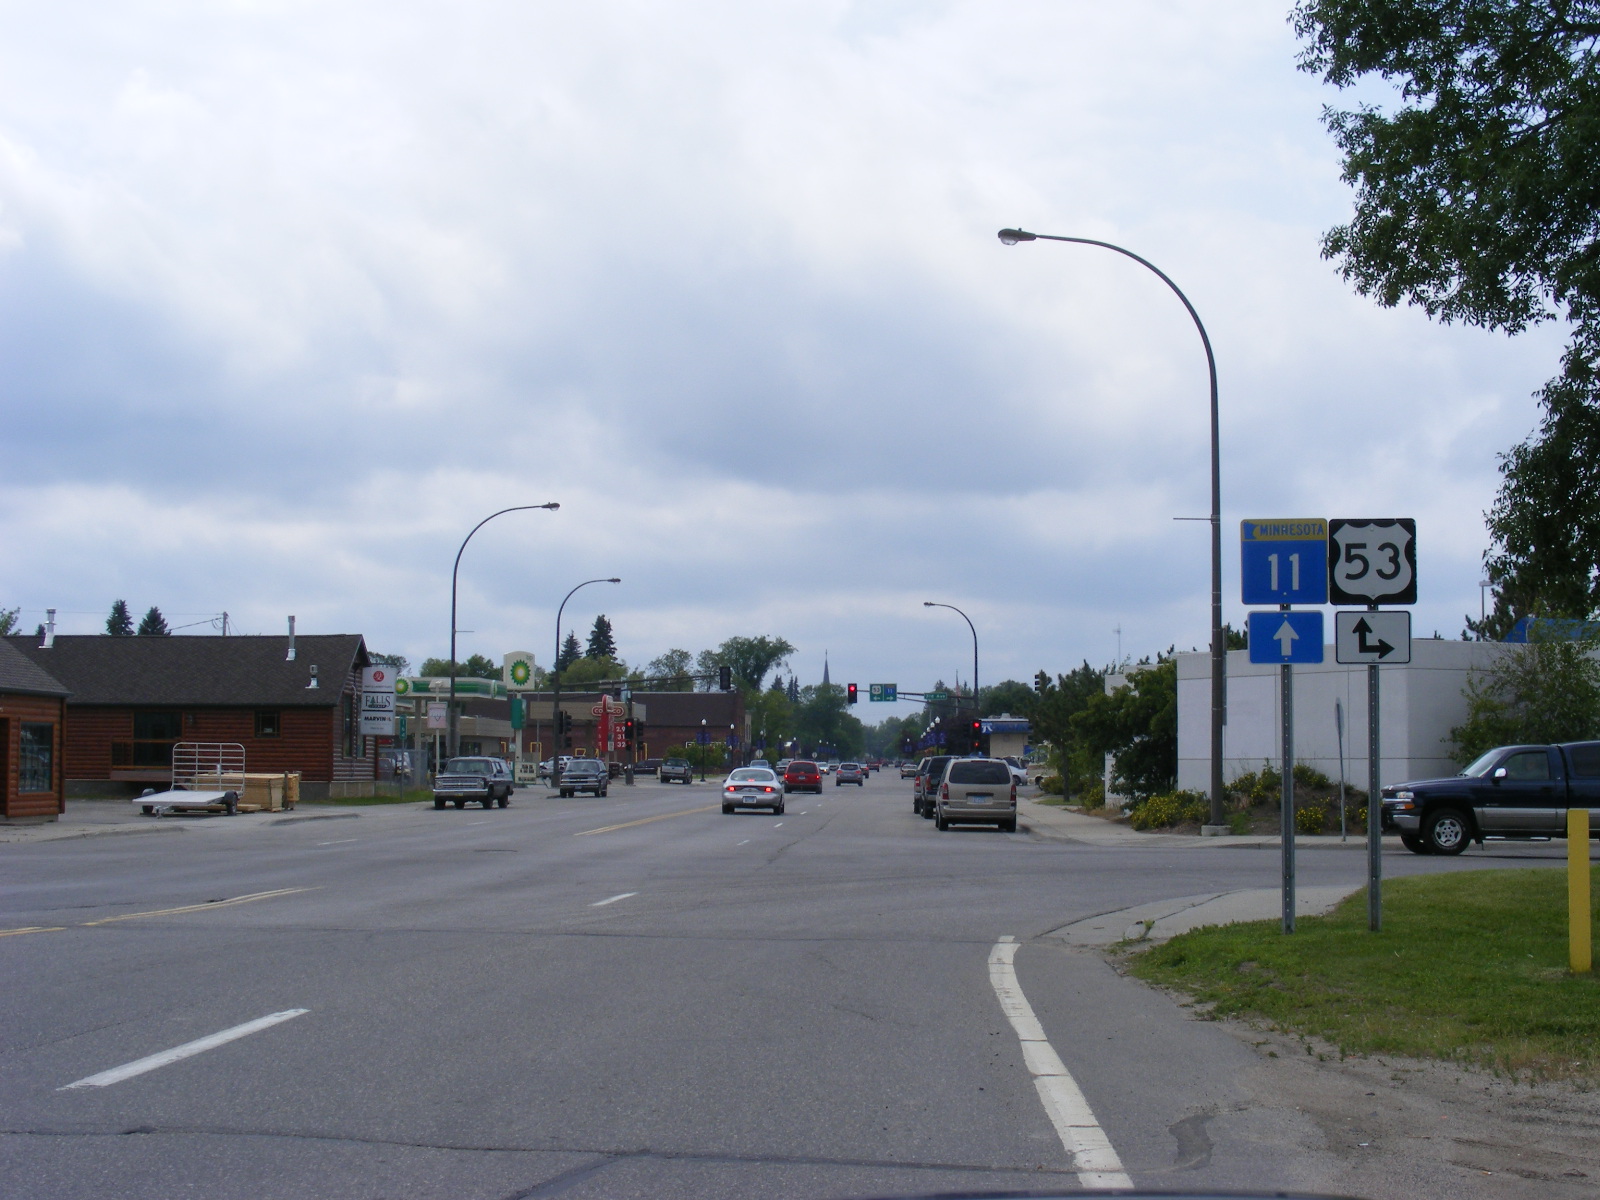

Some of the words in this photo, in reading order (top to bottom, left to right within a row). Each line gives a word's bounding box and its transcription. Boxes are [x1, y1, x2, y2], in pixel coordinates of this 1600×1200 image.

[1259, 523, 1325, 536] MINNESOTA
[1268, 553, 1299, 591] 11
[1344, 542, 1401, 580] 53
[365, 695, 391, 707] FALLS
